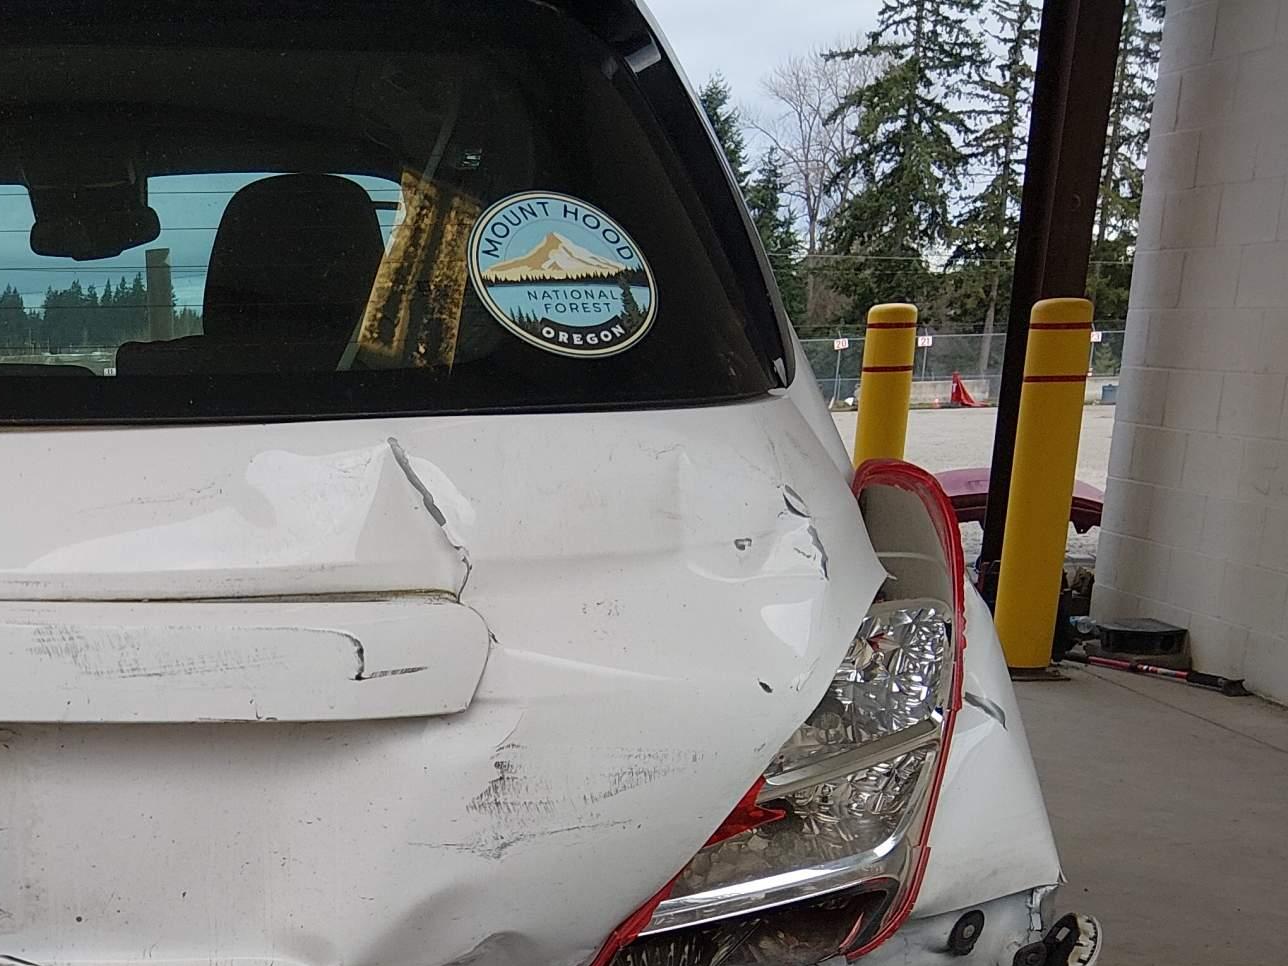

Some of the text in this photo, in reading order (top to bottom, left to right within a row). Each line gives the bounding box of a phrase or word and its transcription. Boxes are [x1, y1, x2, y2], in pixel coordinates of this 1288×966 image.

[482, 201, 633, 260] MOUNT HOOD
[527, 289, 619, 301] NATIONAL
[544, 303, 612, 314] FOREST
[542, 324, 626, 345] OREGON
